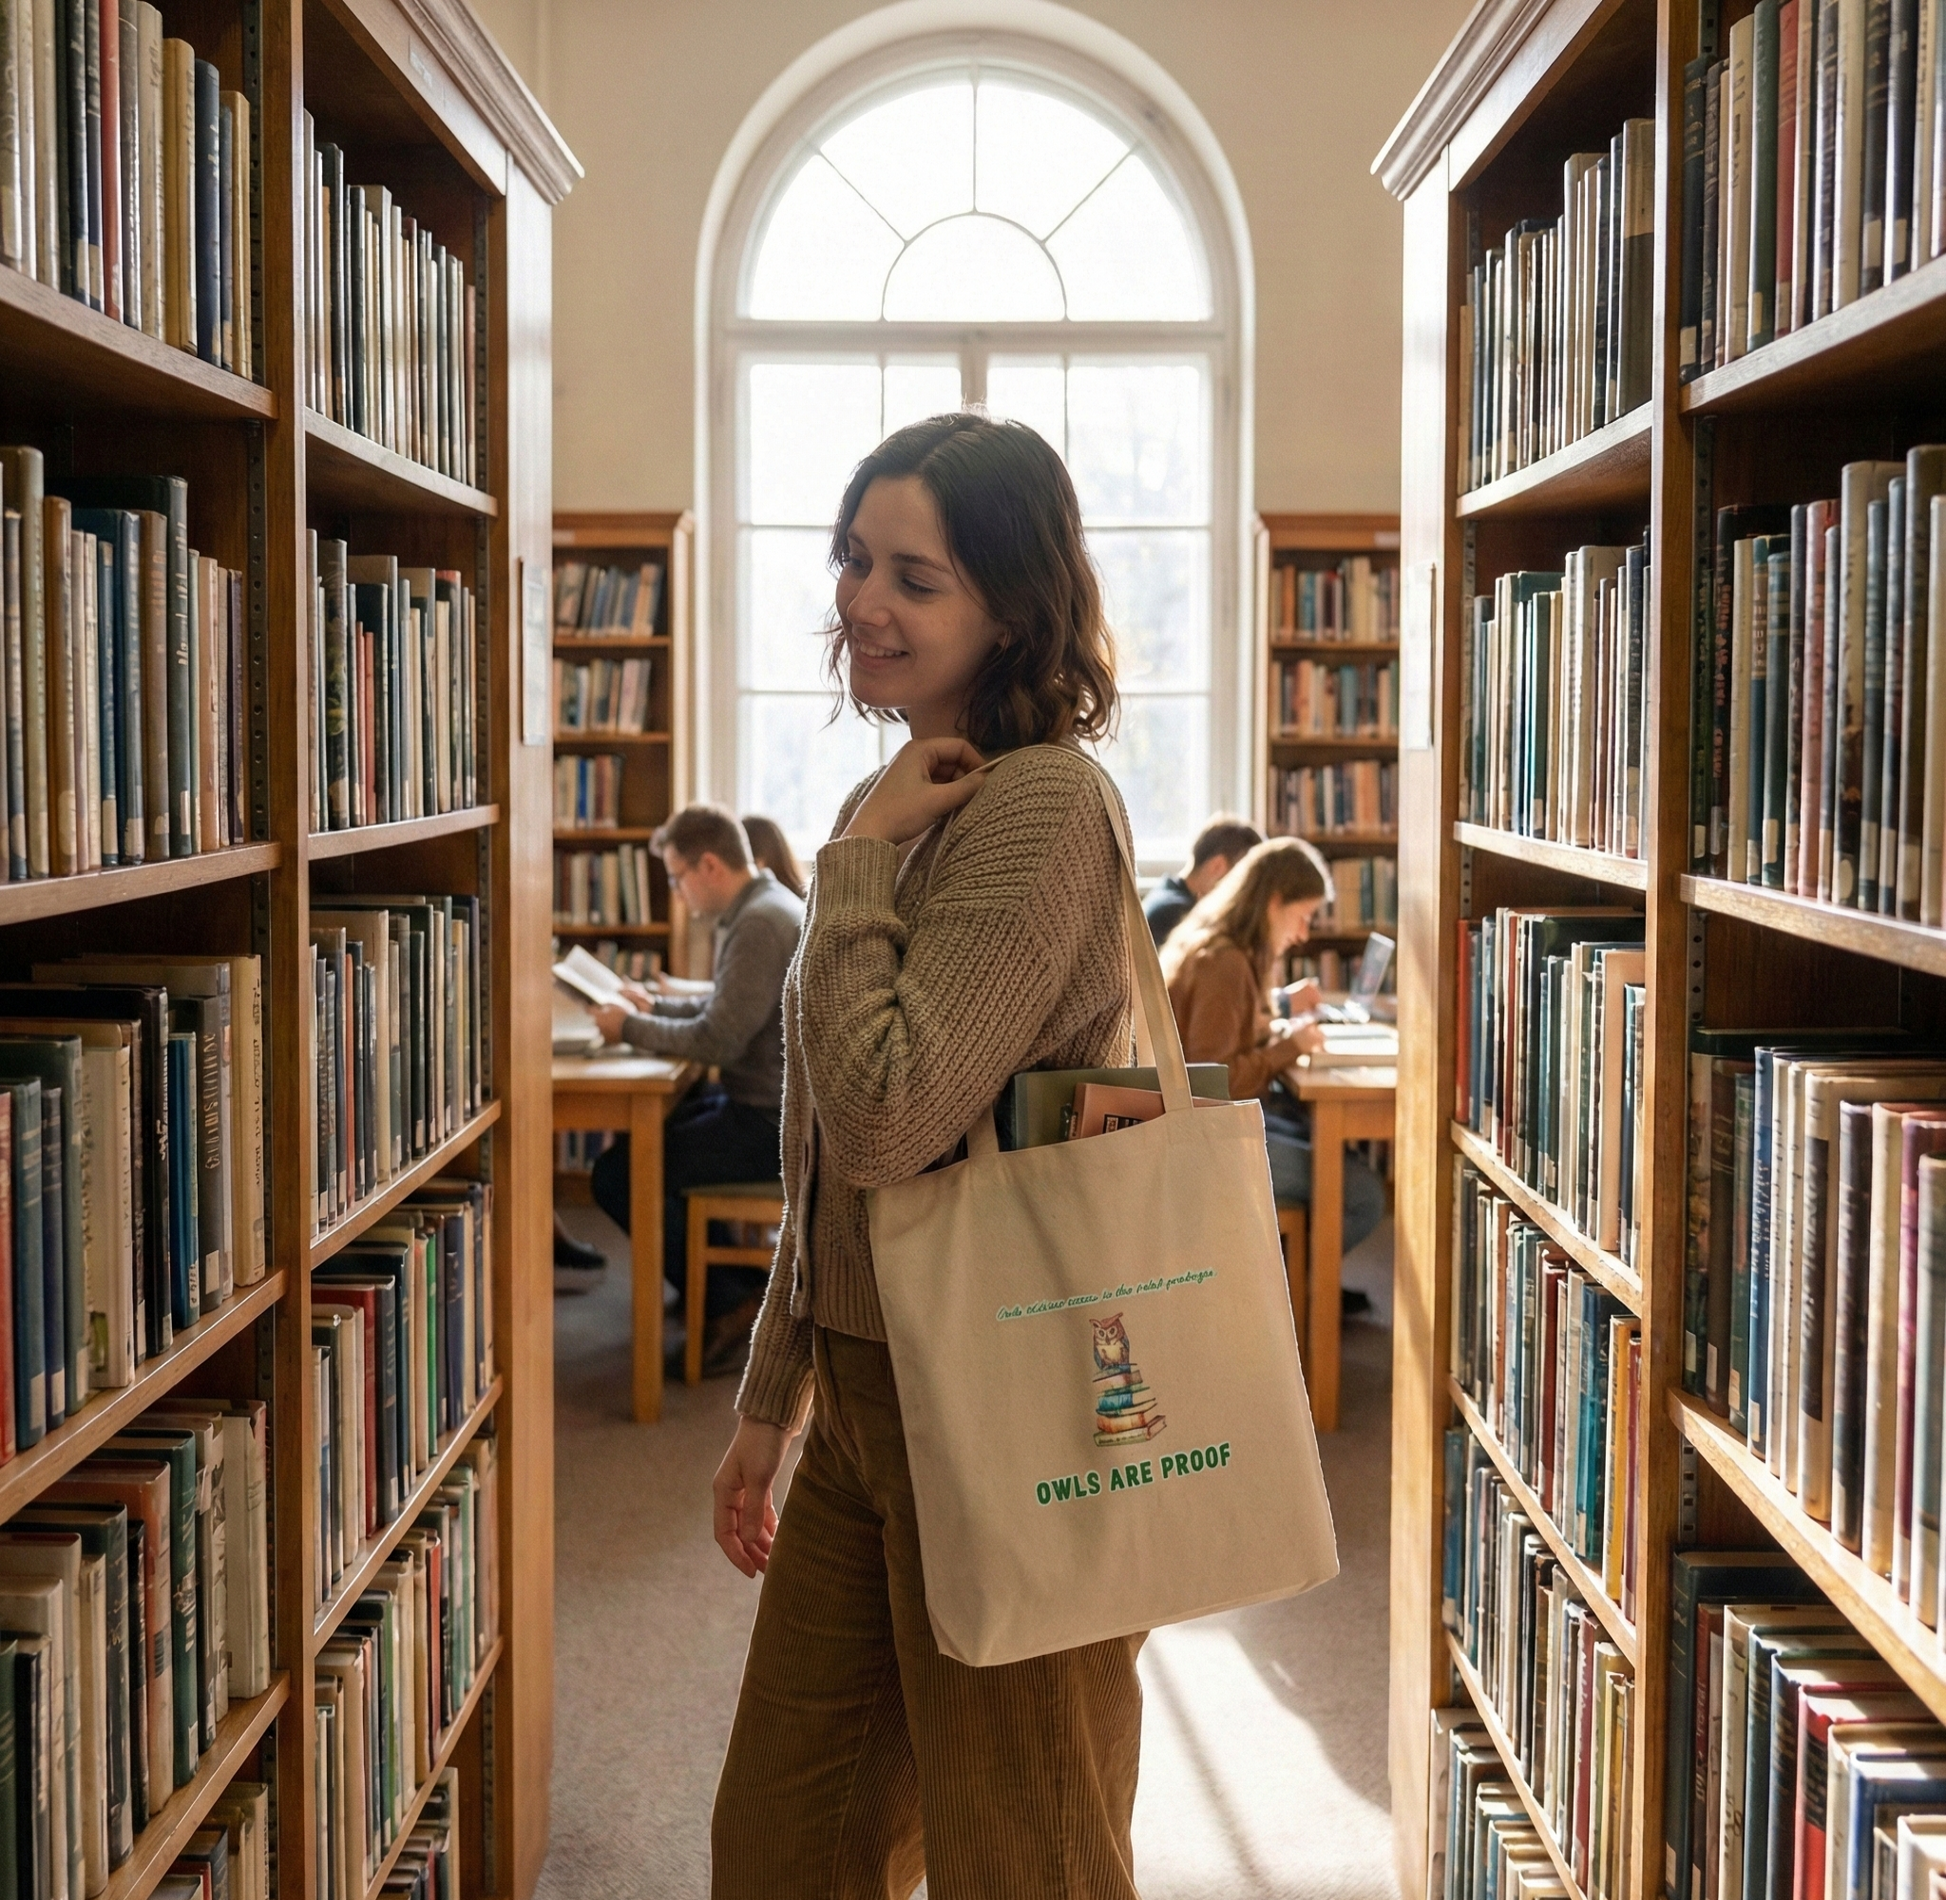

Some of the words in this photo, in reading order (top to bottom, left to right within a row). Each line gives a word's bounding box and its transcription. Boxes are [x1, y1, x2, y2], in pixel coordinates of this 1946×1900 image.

[1036, 1472, 1101, 1505] OWLS
[1110, 1460, 1154, 1491] ARE
[1160, 1442, 1231, 1479] PROOF
